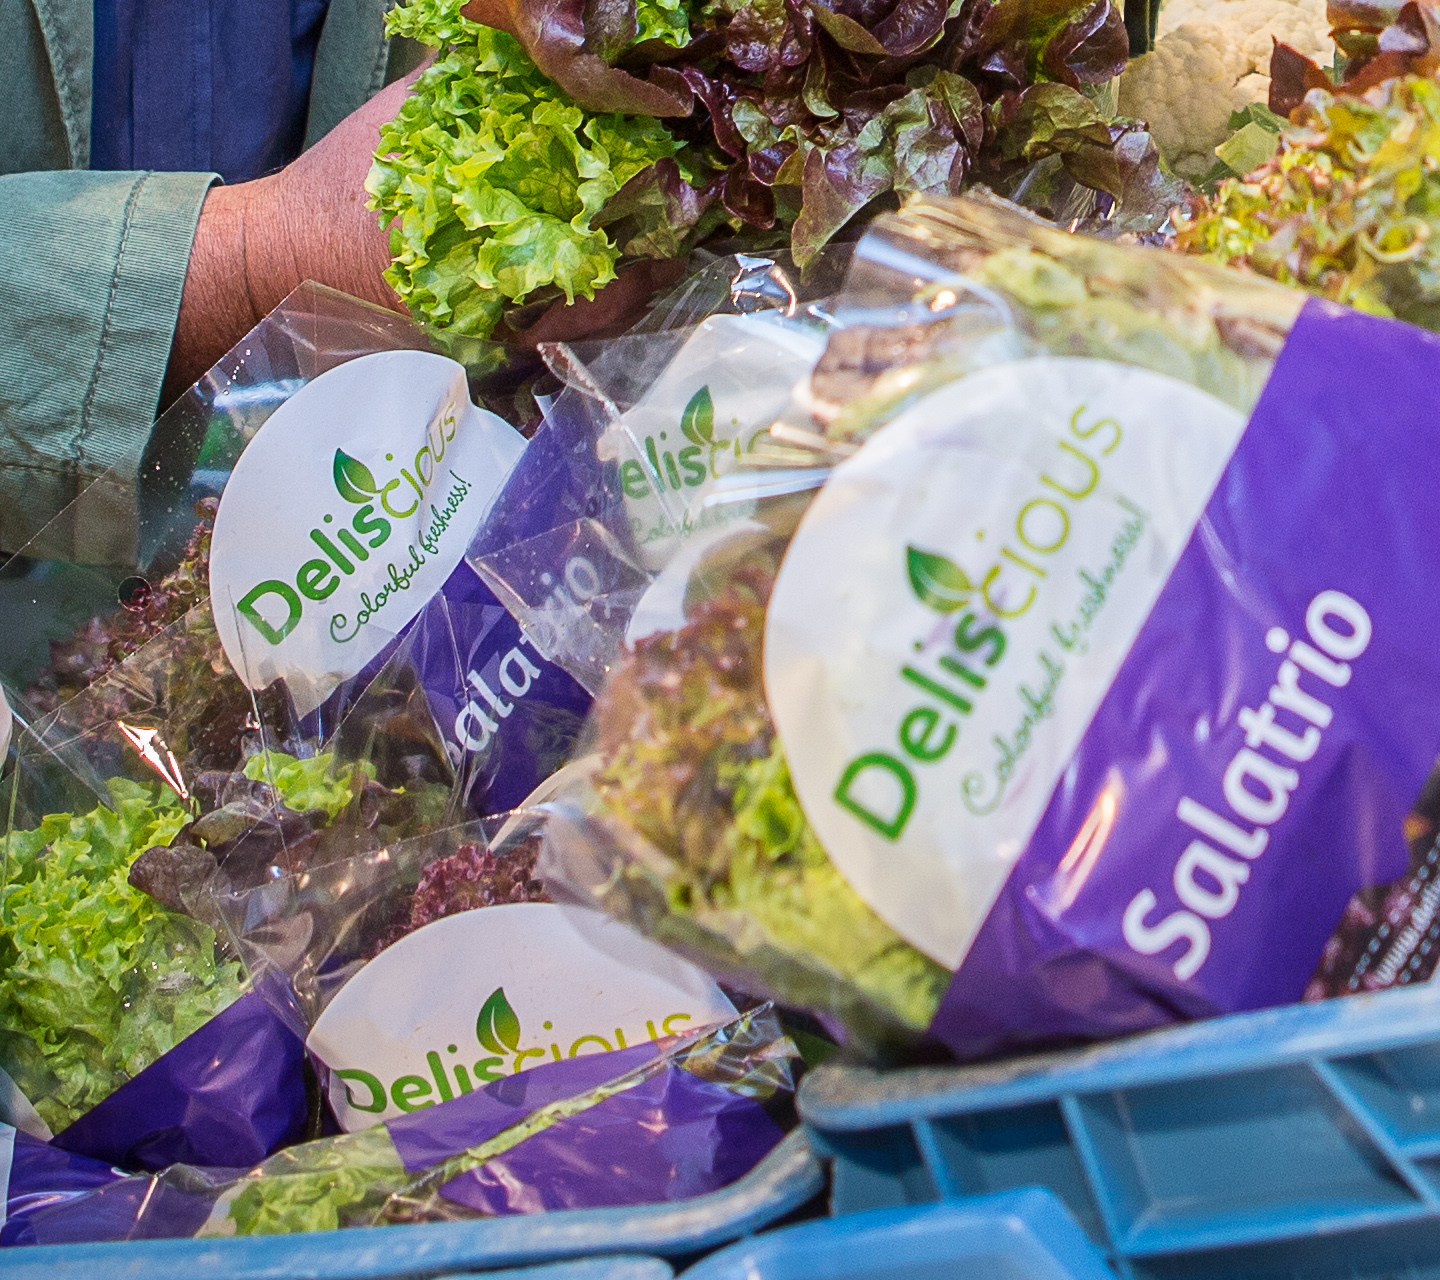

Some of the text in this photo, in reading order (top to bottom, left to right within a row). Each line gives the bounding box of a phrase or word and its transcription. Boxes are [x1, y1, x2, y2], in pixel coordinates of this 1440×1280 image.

[236, 401, 457, 646] Deliscious
[329, 544, 426, 644] Colorful
[833, 405, 1124, 842] Deliscious
[1122, 589, 1372, 982] Salatrio
